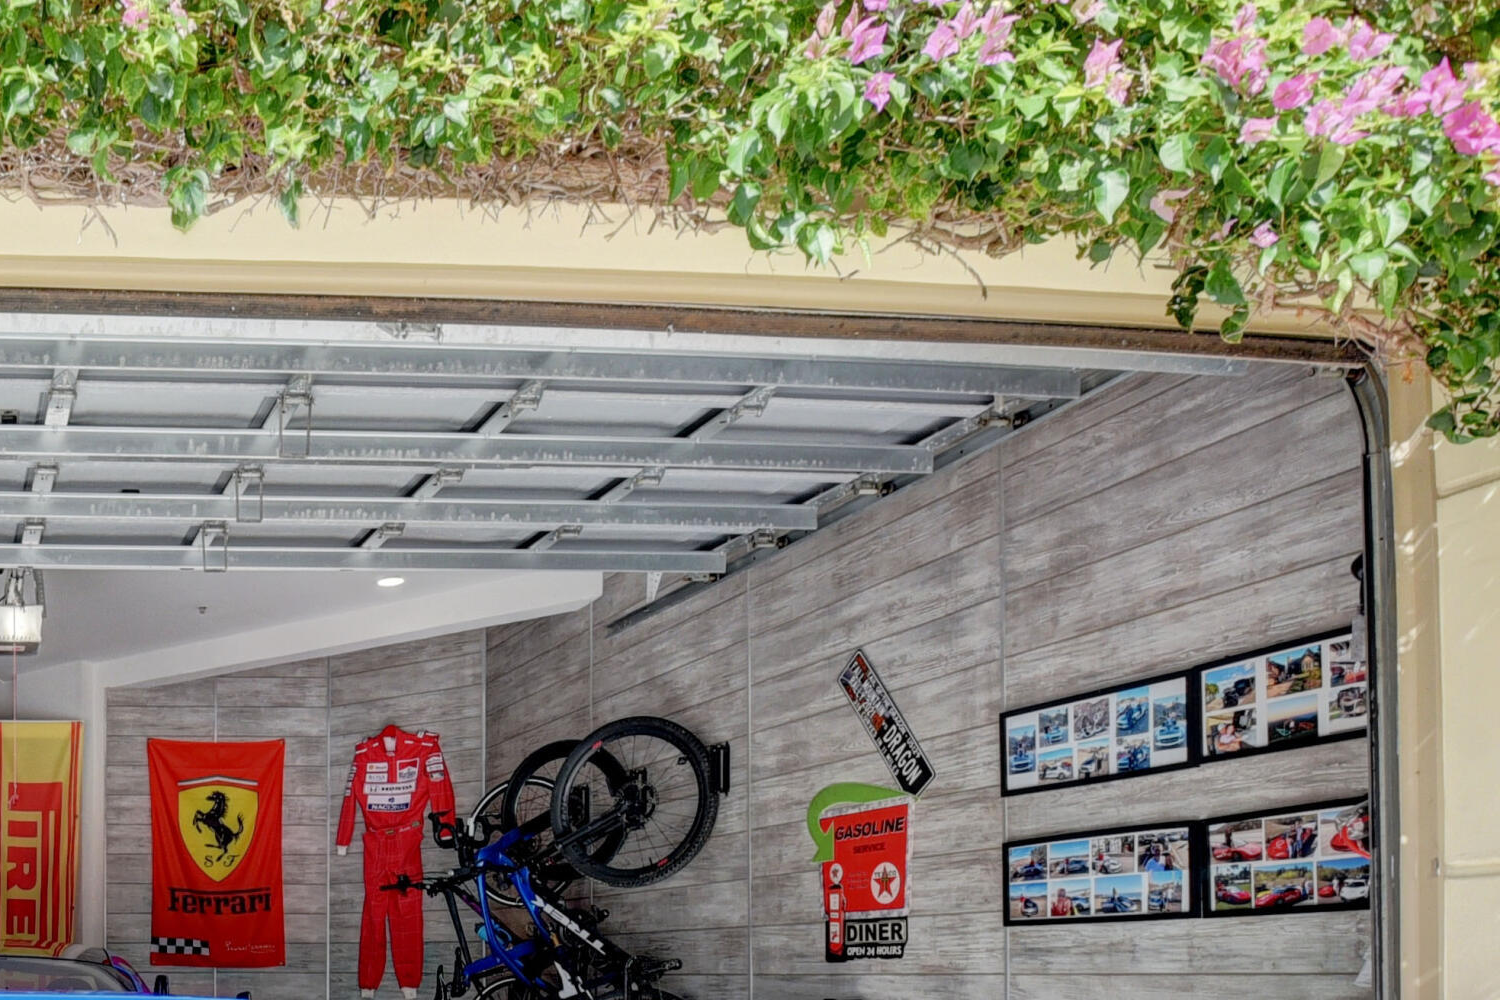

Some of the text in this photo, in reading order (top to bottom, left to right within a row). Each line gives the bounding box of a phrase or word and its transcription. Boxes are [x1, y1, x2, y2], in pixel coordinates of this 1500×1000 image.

[882, 723, 922, 786] DRAGON
[835, 817, 904, 841] GASOLINE
[853, 842, 886, 855] SERVICE
[7, 782, 63, 947] PIRE
[204, 855, 214, 867] S
[167, 887, 272, 915] Ferrari
[530, 894, 606, 955] TREK
[847, 922, 903, 942] DINER
[847, 945, 902, 956] OPEN 24 HOURS
